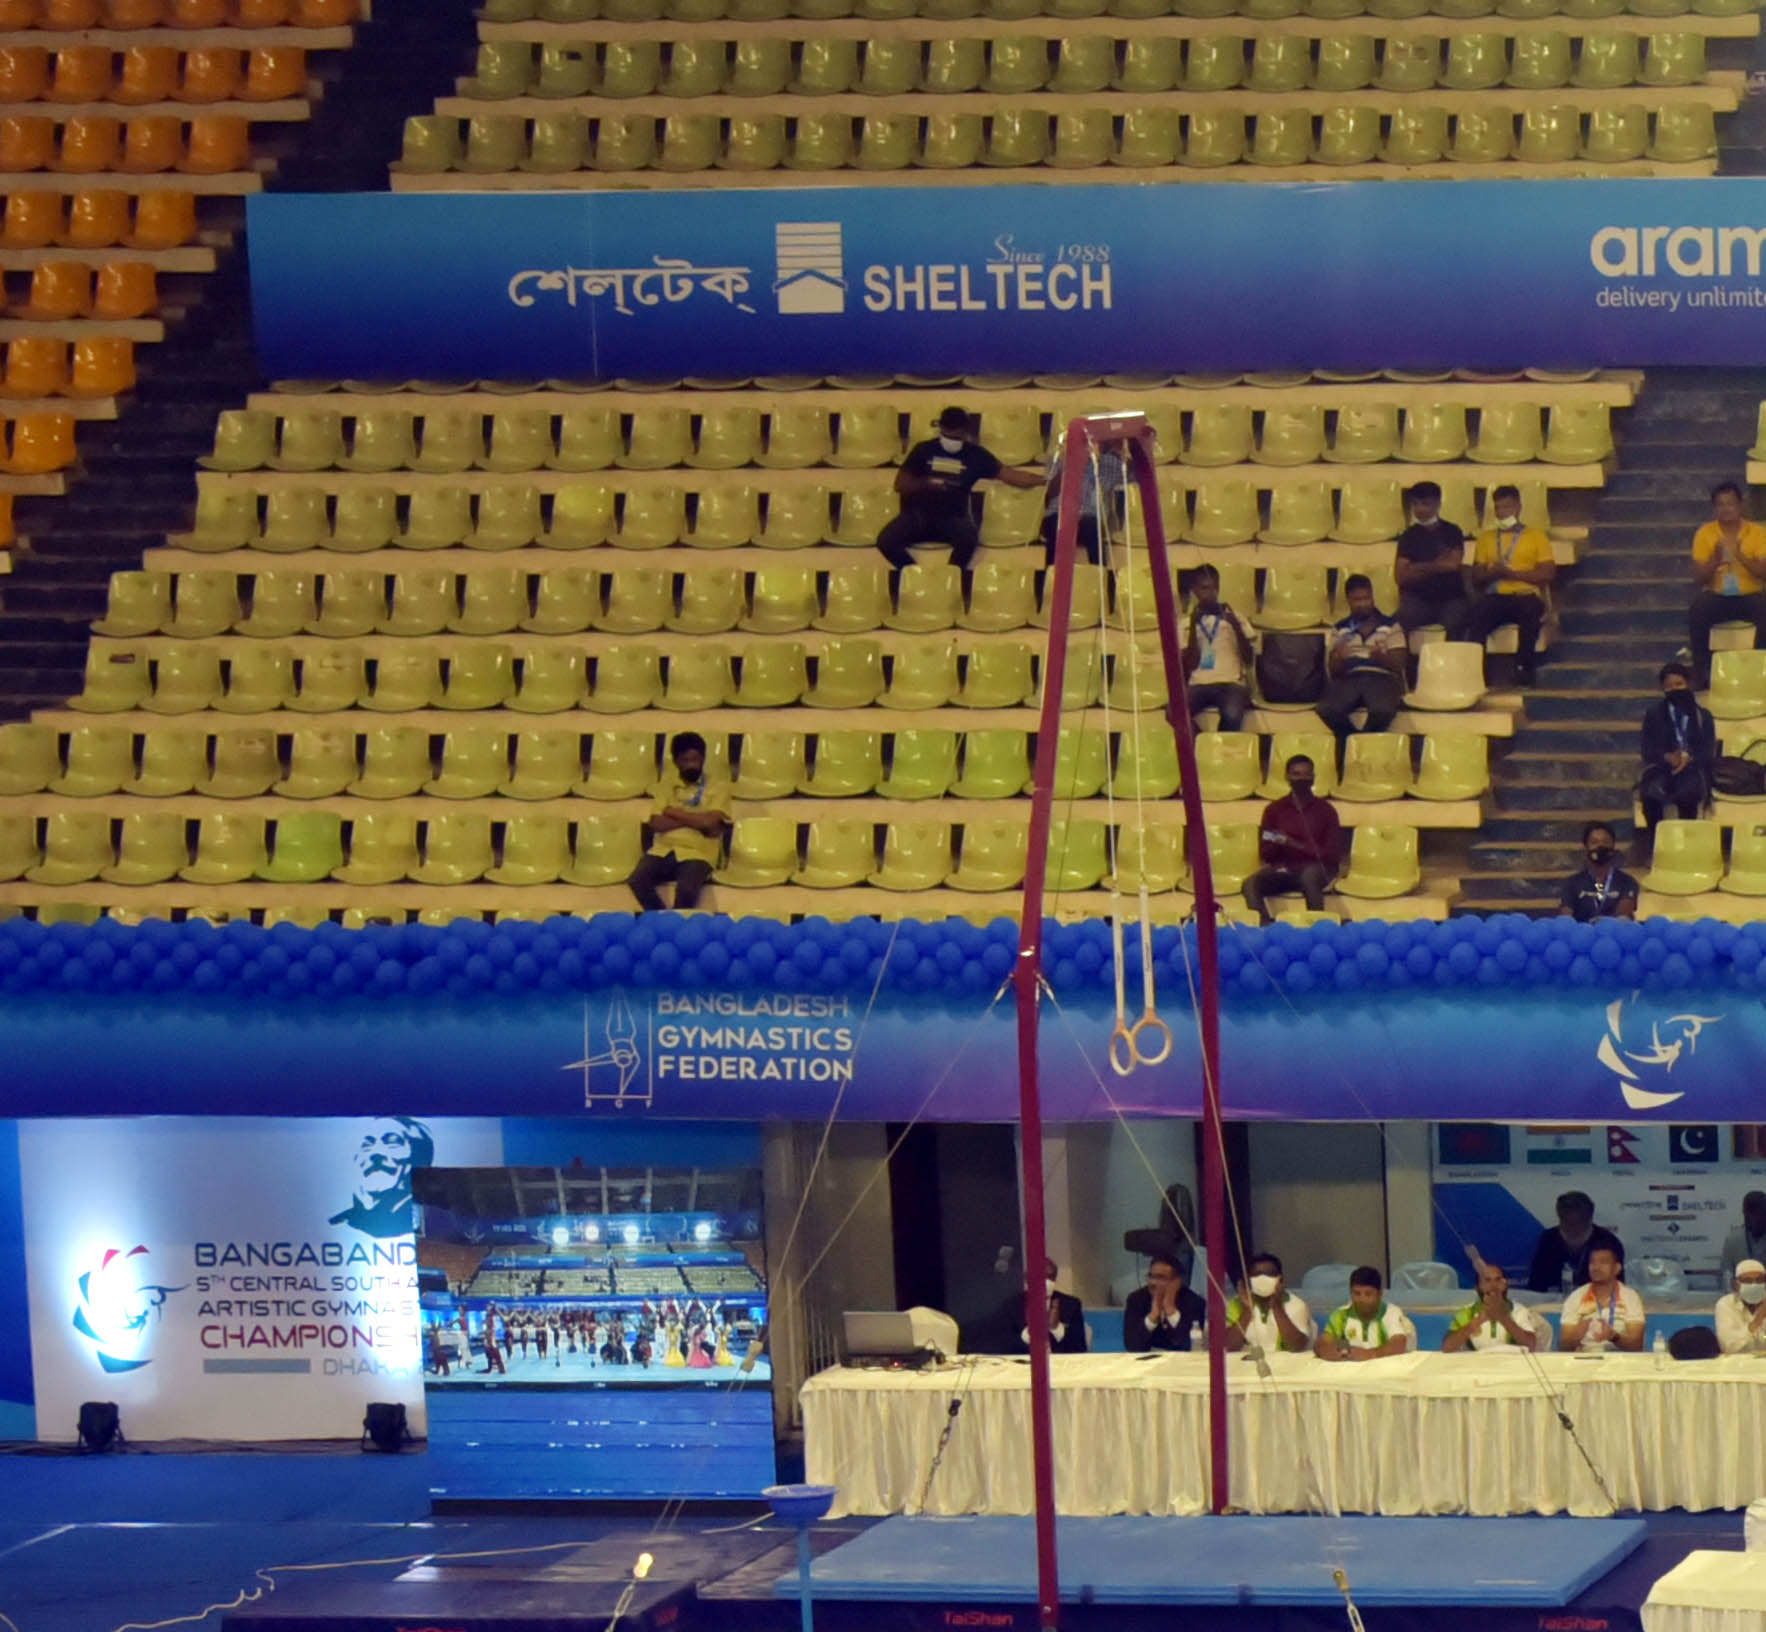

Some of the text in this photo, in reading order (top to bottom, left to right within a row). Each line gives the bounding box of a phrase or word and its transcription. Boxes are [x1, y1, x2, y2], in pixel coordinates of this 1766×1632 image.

[986, 232, 1111, 264] Since 1988
[864, 264, 1112, 311] SHELTECH
[1595, 285, 1681, 312] delivery
[657, 993, 849, 1017] BANGLADESH
[658, 1025, 853, 1051] GYMNASTICS
[658, 1055, 853, 1081] FEDERATION
[230, 1276, 327, 1292] CENTRAL
[198, 1300, 307, 1317] ARTISTIC
[944, 1611, 1013, 1626] TaiShan
[1538, 1616, 1608, 1630] TaiShan
